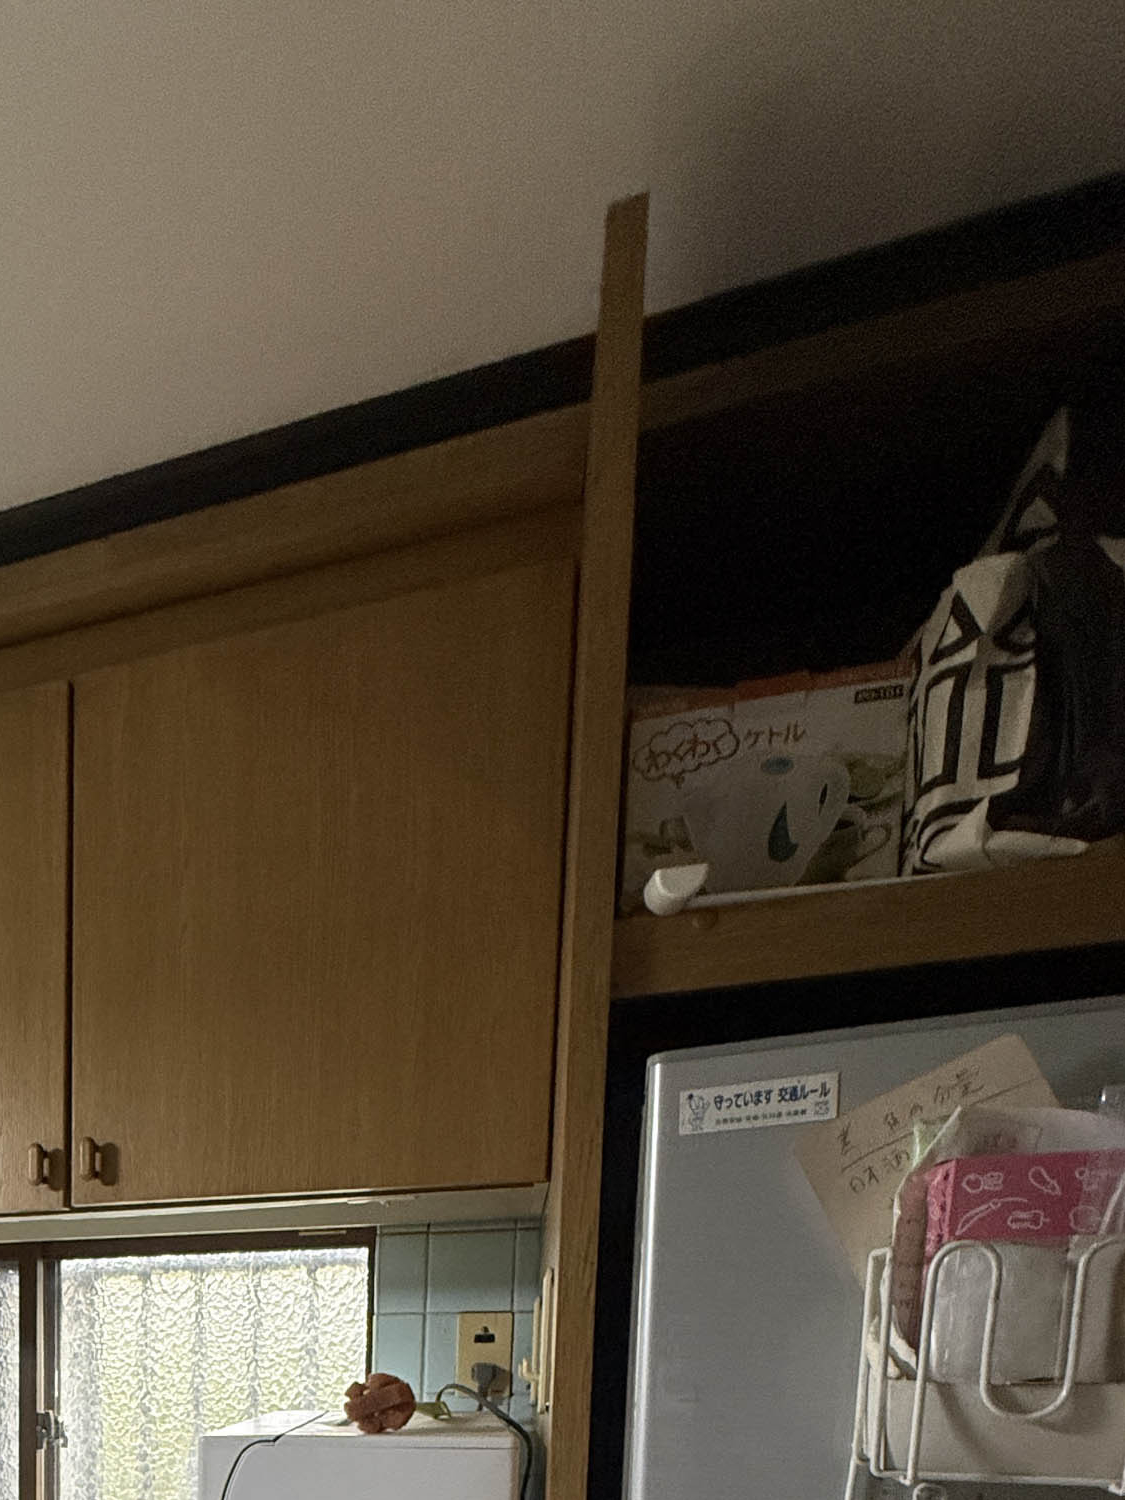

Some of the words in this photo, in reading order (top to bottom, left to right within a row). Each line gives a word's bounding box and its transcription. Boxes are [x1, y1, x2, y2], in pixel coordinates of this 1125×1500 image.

[713, 1088, 774, 1111] 守っています
[777, 1081, 831, 1104] 交通ルール
